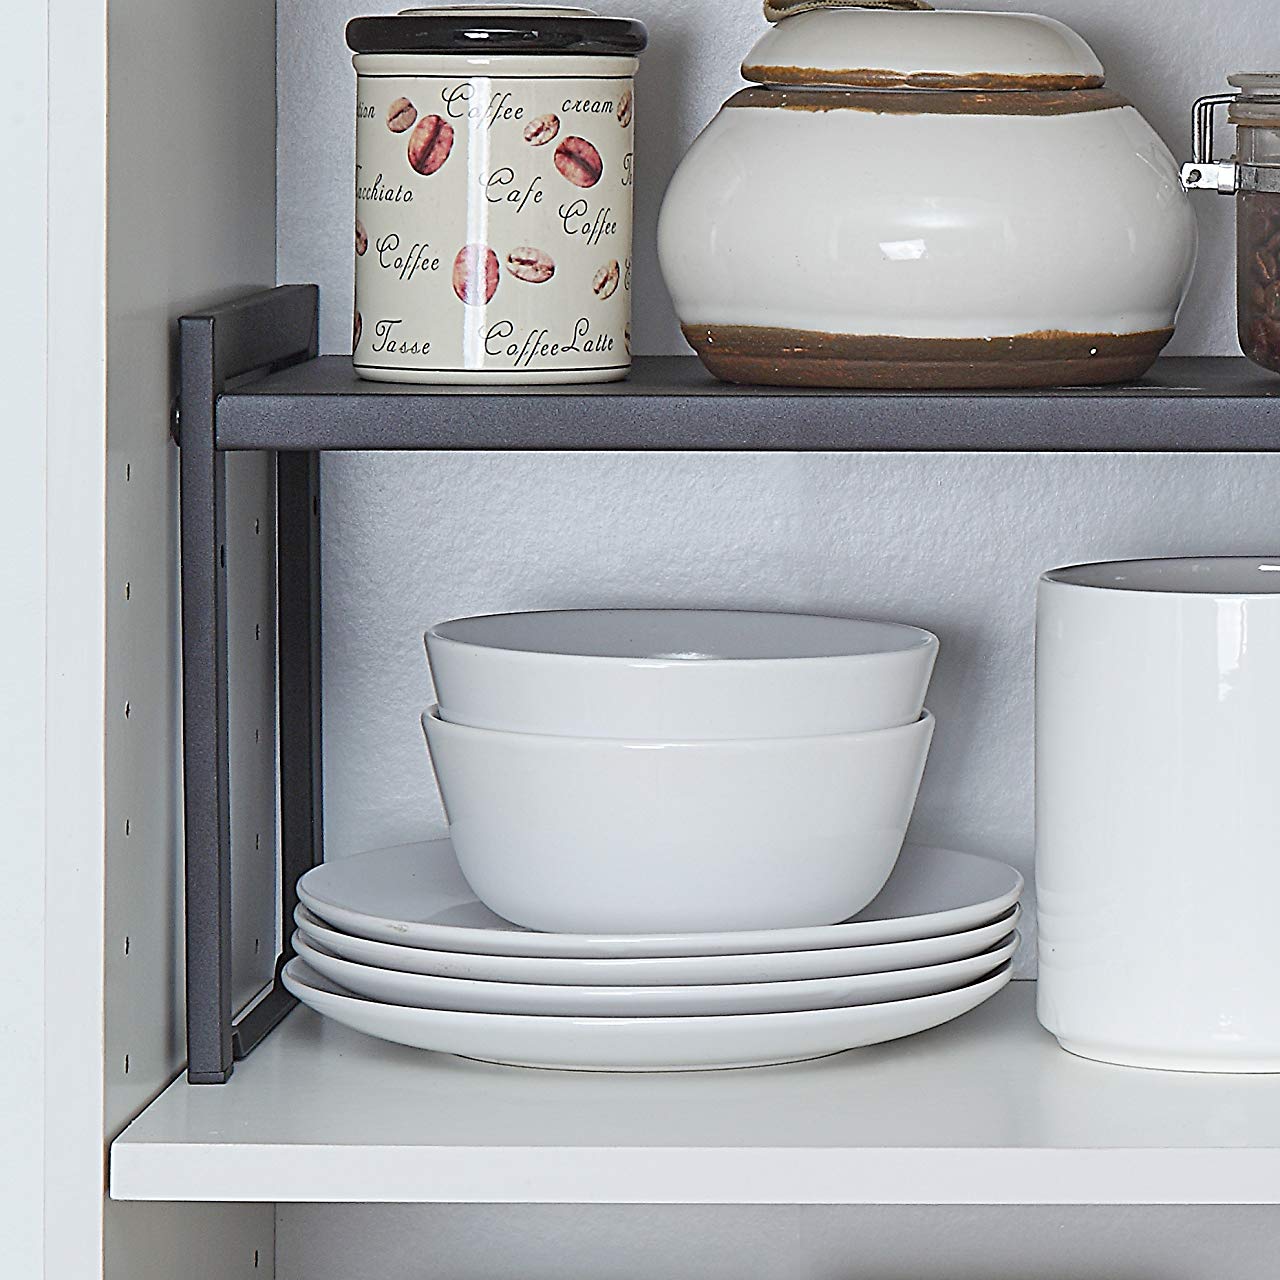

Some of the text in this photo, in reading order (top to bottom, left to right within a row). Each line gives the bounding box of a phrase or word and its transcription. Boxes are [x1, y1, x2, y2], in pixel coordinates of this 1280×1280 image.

[442, 83, 524, 130] Coffee
[561, 98, 613, 114] cream
[480, 167, 543, 213] Cafe
[558, 200, 617, 245] Coffee
[376, 234, 440, 280] Coffee
[372, 319, 431, 355] Tasse
[480, 318, 613, 366] Coffee Latte
